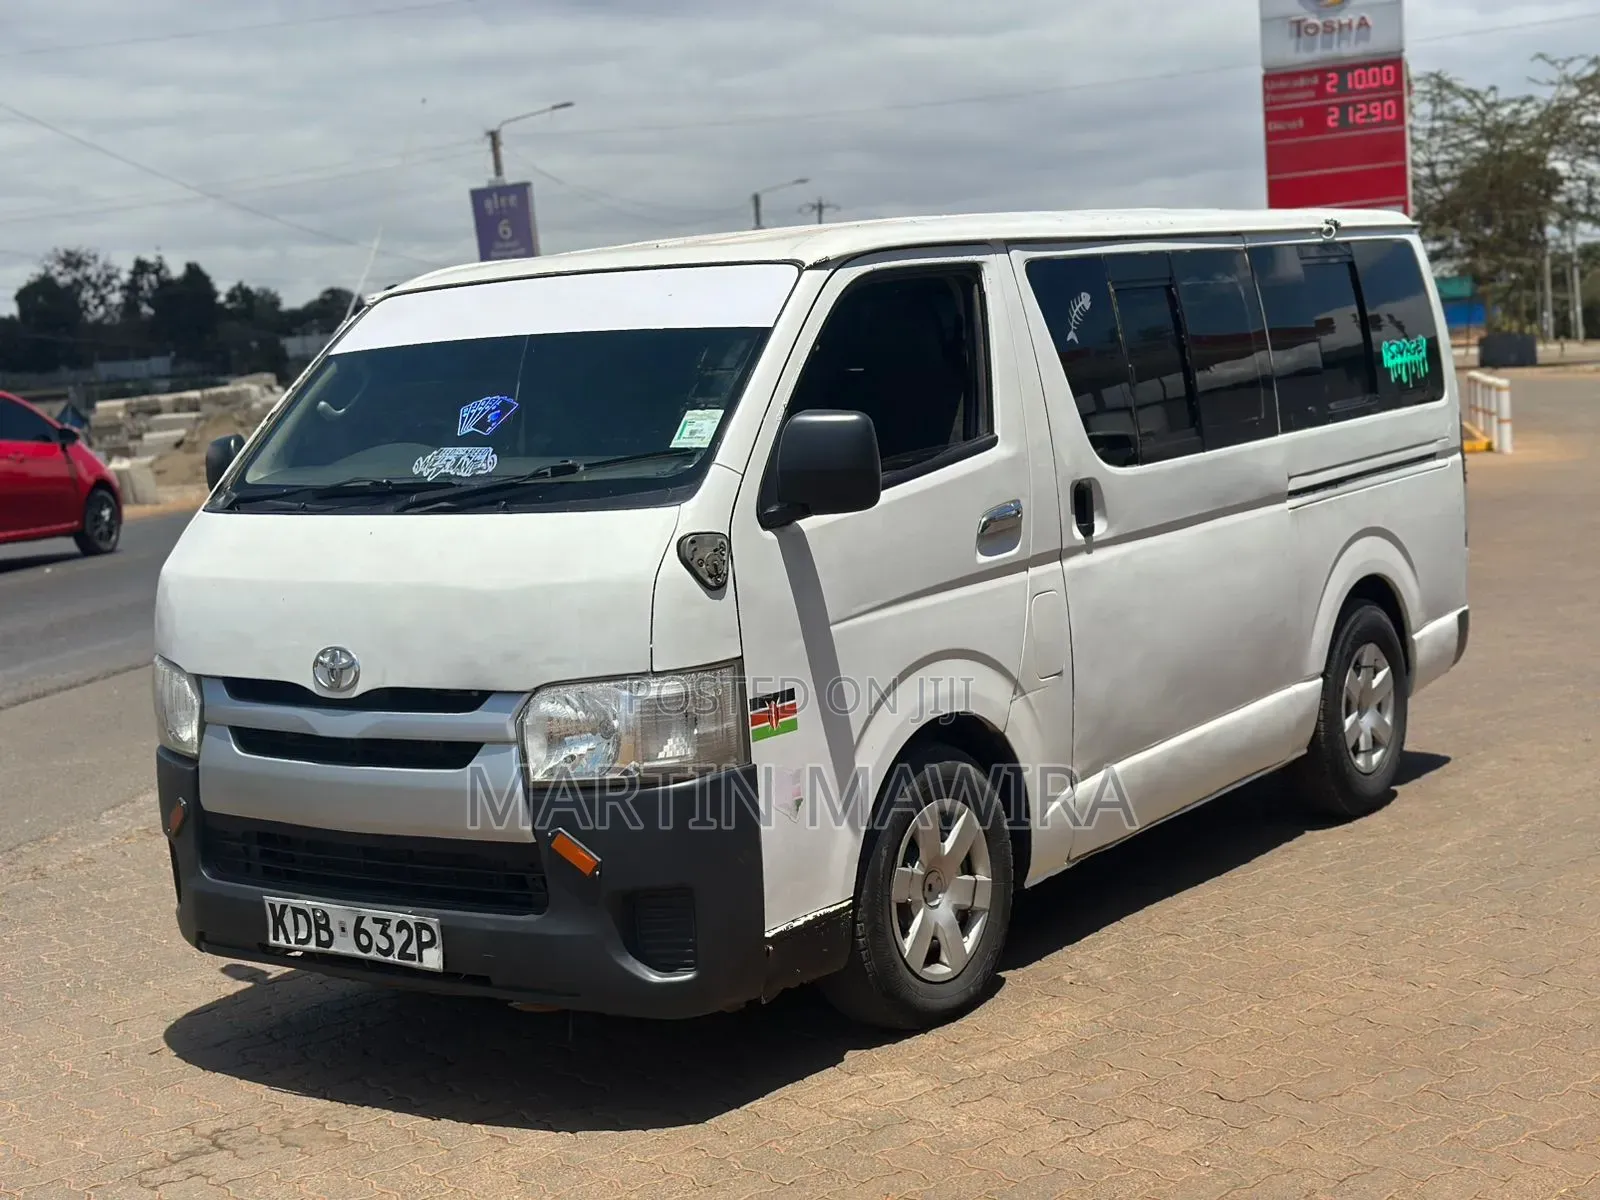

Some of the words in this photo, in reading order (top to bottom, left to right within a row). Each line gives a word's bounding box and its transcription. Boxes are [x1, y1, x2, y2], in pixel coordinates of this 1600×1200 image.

[1288, 14, 1373, 38] TOSHA
[498, 219, 512, 240] 6
[268, 903, 334, 949] KDB
[353, 915, 437, 963] 632P
